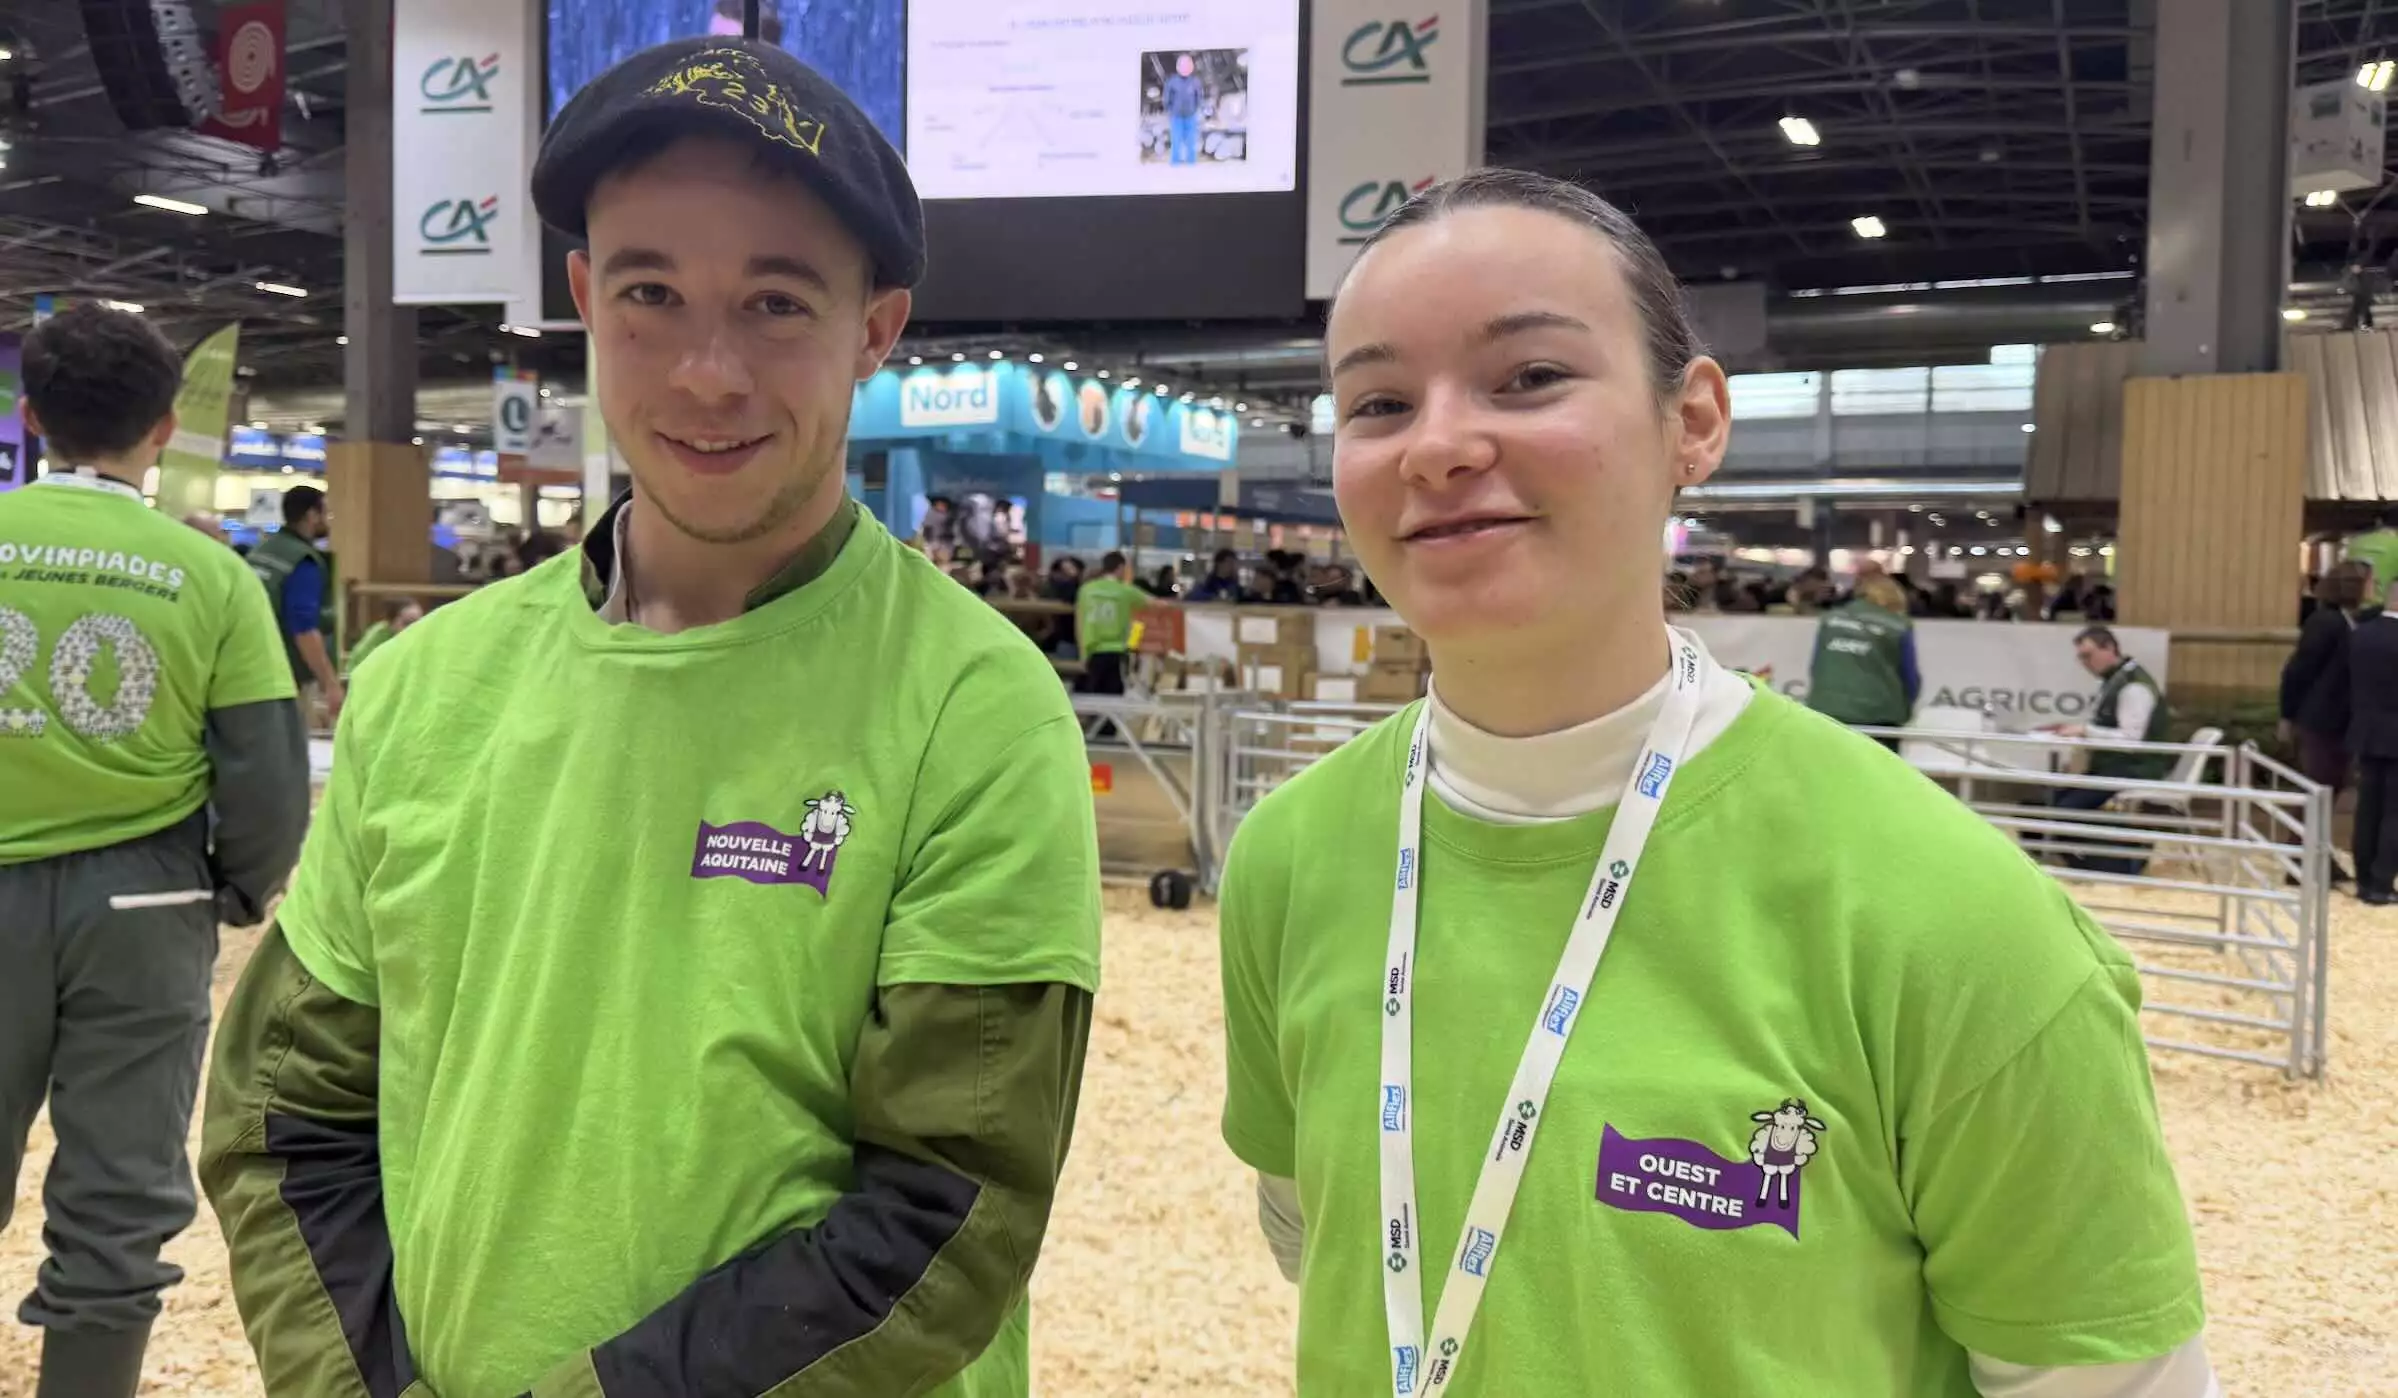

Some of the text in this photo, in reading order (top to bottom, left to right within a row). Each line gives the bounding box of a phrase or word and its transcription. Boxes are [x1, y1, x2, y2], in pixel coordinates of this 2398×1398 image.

[911, 386, 988, 412] Nord
[0, 542, 185, 588] OVINPIADES
[13, 568, 91, 585] JEUNES
[94, 573, 180, 603] BERGERS
[706, 834, 793, 858] NOUVELLE
[700, 853, 790, 877] AQUITAINE
[1601, 880, 1619, 909] MSD
[1389, 967, 1399, 994] MSD
[1511, 1120, 1527, 1151] MSD
[1639, 1154, 1721, 1187] OUEST
[1610, 1172, 1745, 1218] ET CENTRE
[1390, 1218, 1401, 1249] MSD
[1433, 1359, 1450, 1385] MSD
